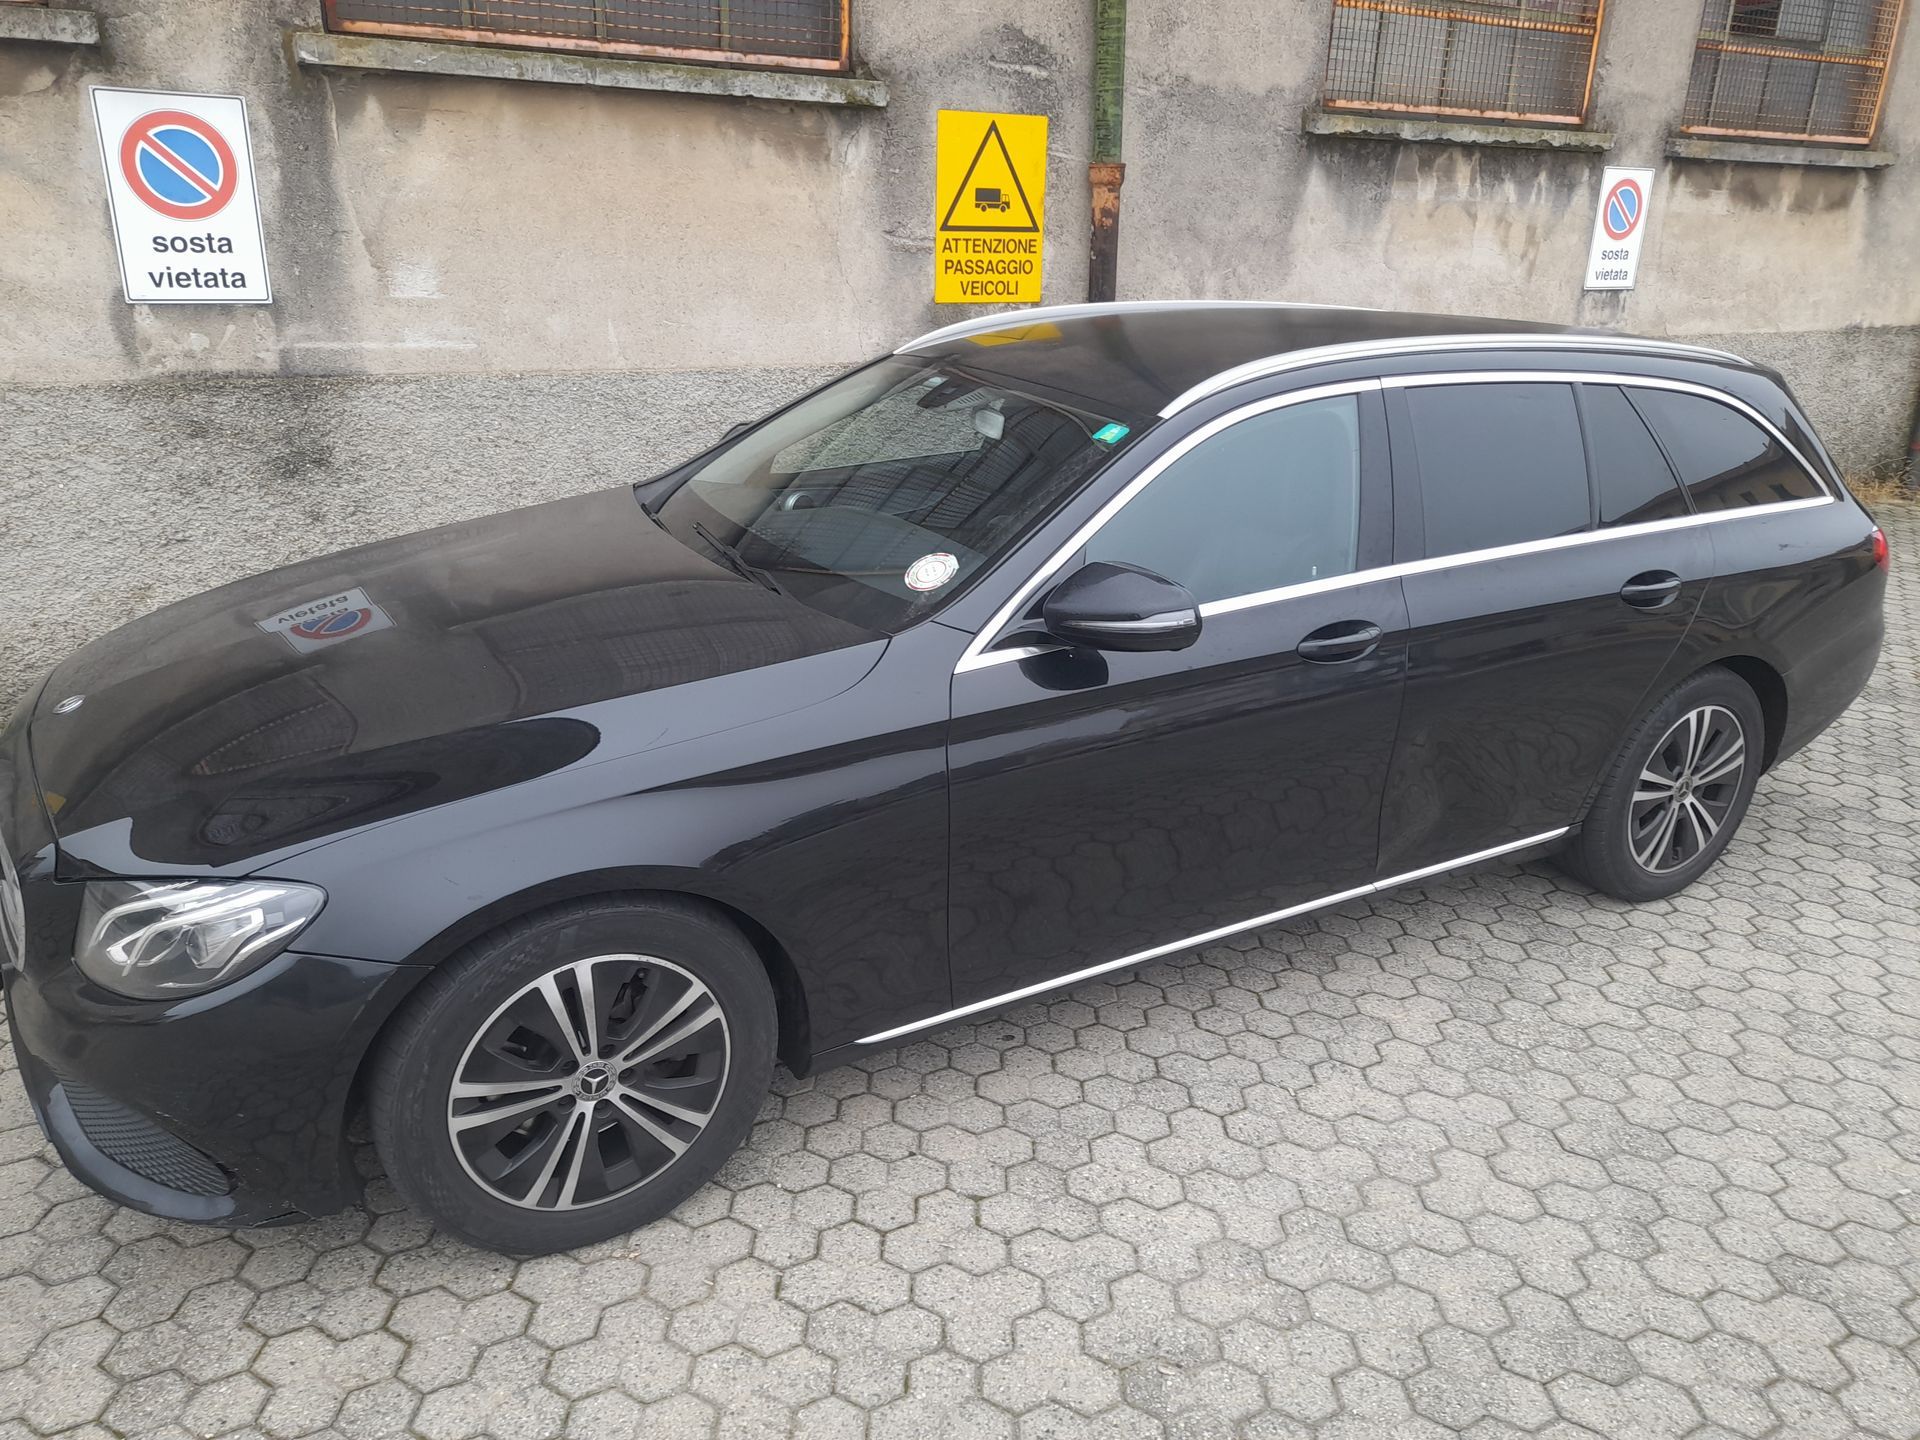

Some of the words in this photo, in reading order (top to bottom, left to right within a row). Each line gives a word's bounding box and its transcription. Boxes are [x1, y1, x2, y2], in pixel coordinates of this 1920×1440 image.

[152, 233, 233, 253] sosta
[942, 238, 1037, 254] ATTENZIONE
[1601, 248, 1629, 260] sosta
[944, 259, 1033, 275] PASSAGGIO
[1595, 268, 1628, 281] vietata
[148, 267, 247, 288] vietata
[960, 280, 1018, 296] VEICOLI
